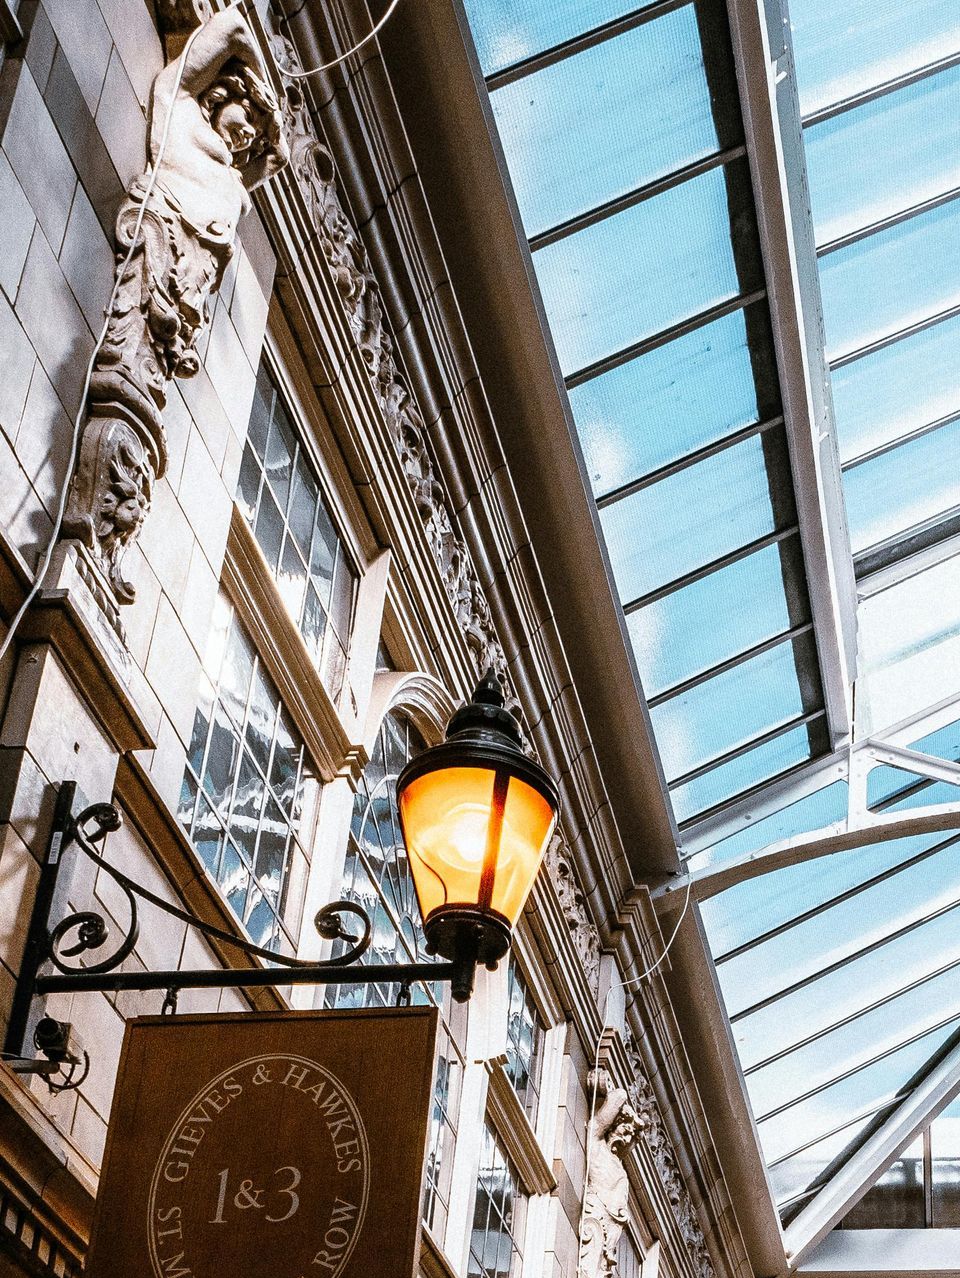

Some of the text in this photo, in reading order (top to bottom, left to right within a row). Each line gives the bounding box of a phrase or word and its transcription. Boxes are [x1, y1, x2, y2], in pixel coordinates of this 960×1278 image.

[164, 1064, 362, 1183] GIEVES & HAWKES
[208, 1166, 301, 1223] 1&3
[313, 1196, 359, 1271] ROW
